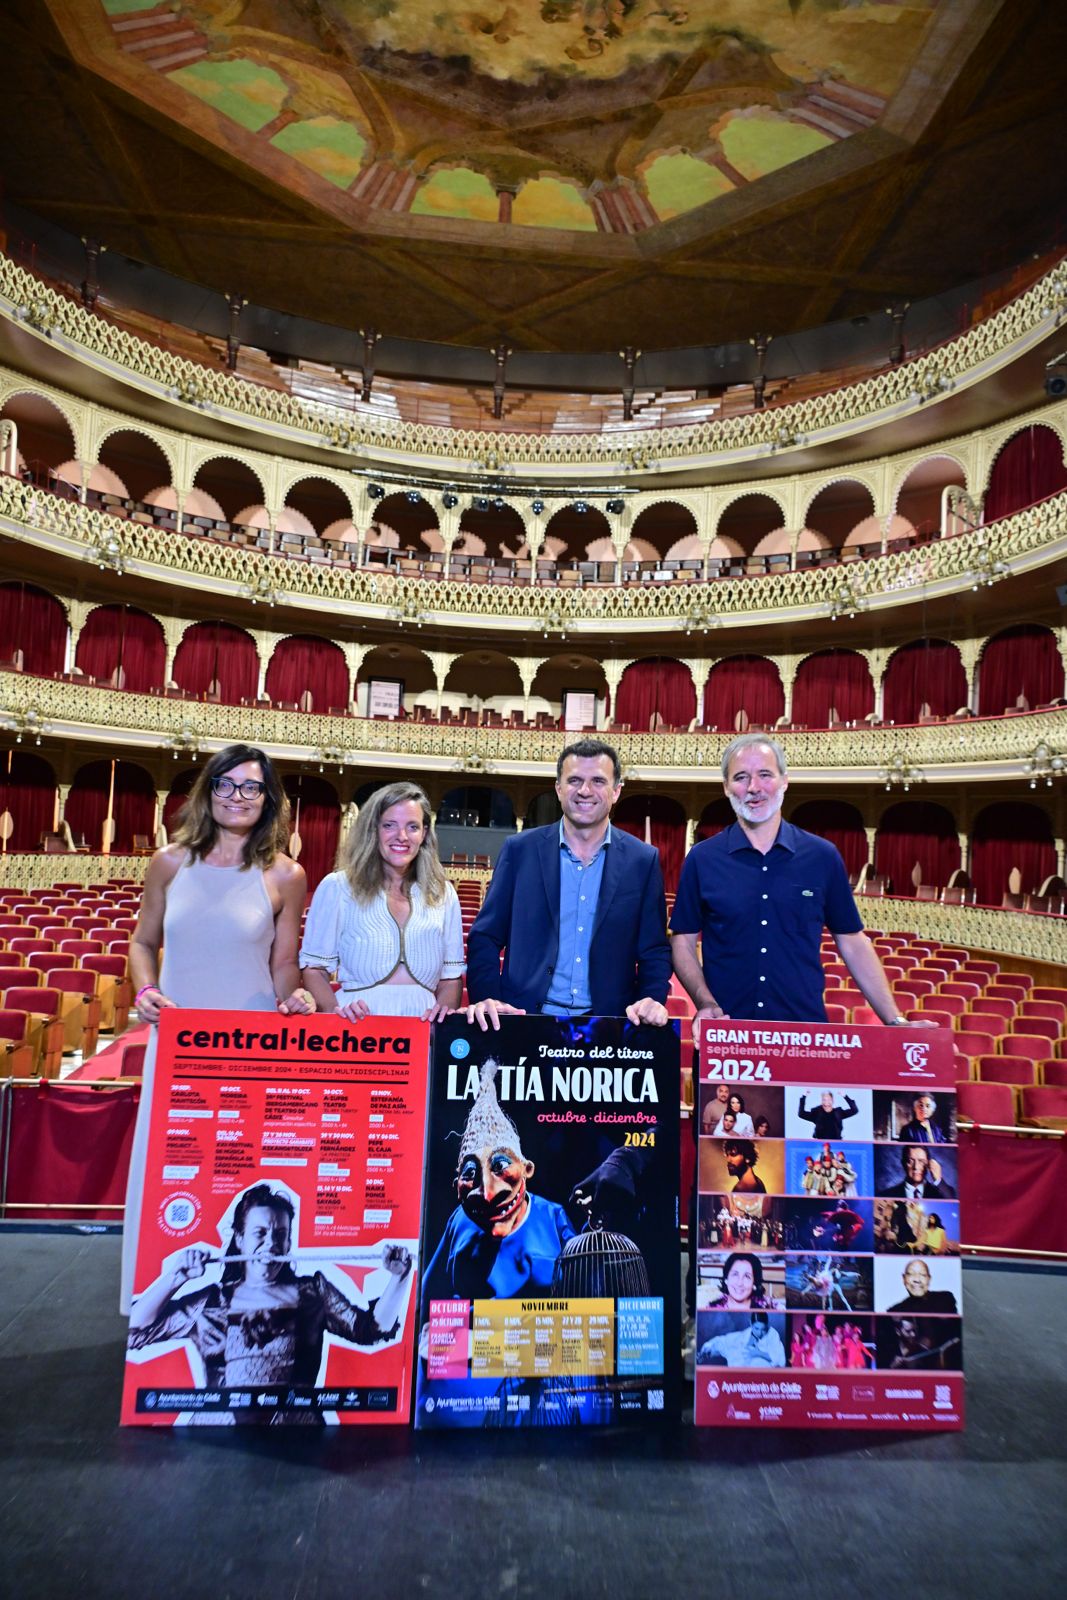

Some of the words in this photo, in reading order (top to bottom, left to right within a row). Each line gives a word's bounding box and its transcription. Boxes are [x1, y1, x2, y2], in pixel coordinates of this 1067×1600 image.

[706, 1028, 749, 1044] GRAN
[752, 1030, 812, 1046] TEATRO
[815, 1033, 862, 1048] FALLA
[538, 1045, 585, 1059] Teatro
[589, 1046, 614, 1060] del
[617, 1046, 654, 1060] títere
[706, 1045, 851, 1060] septiembre/diciembre
[229, 1065, 272, 1073] DICIEMBRE
[299, 1067, 332, 1075] ESPACIO
[334, 1068, 410, 1077] MULTIDISCIPLINAR
[707, 1059, 772, 1082] 2024
[447, 1064, 481, 1101] LA
[498, 1057, 544, 1101] TÍA
[552, 1066, 659, 1103] NORICA
[537, 1111, 587, 1123] octubre
[593, 1112, 658, 1124] diciembre
[624, 1132, 655, 1147] 2024
[431, 1302, 468, 1313] OCTUBRE
[521, 1301, 569, 1312] NOVIEMBRE
[619, 1300, 661, 1311] DICIEMBRE
[721, 1381, 769, 1394] Ayuntamiento
[770, 1383, 779, 1392] de
[436, 1397, 474, 1408] Ayuntamiento
